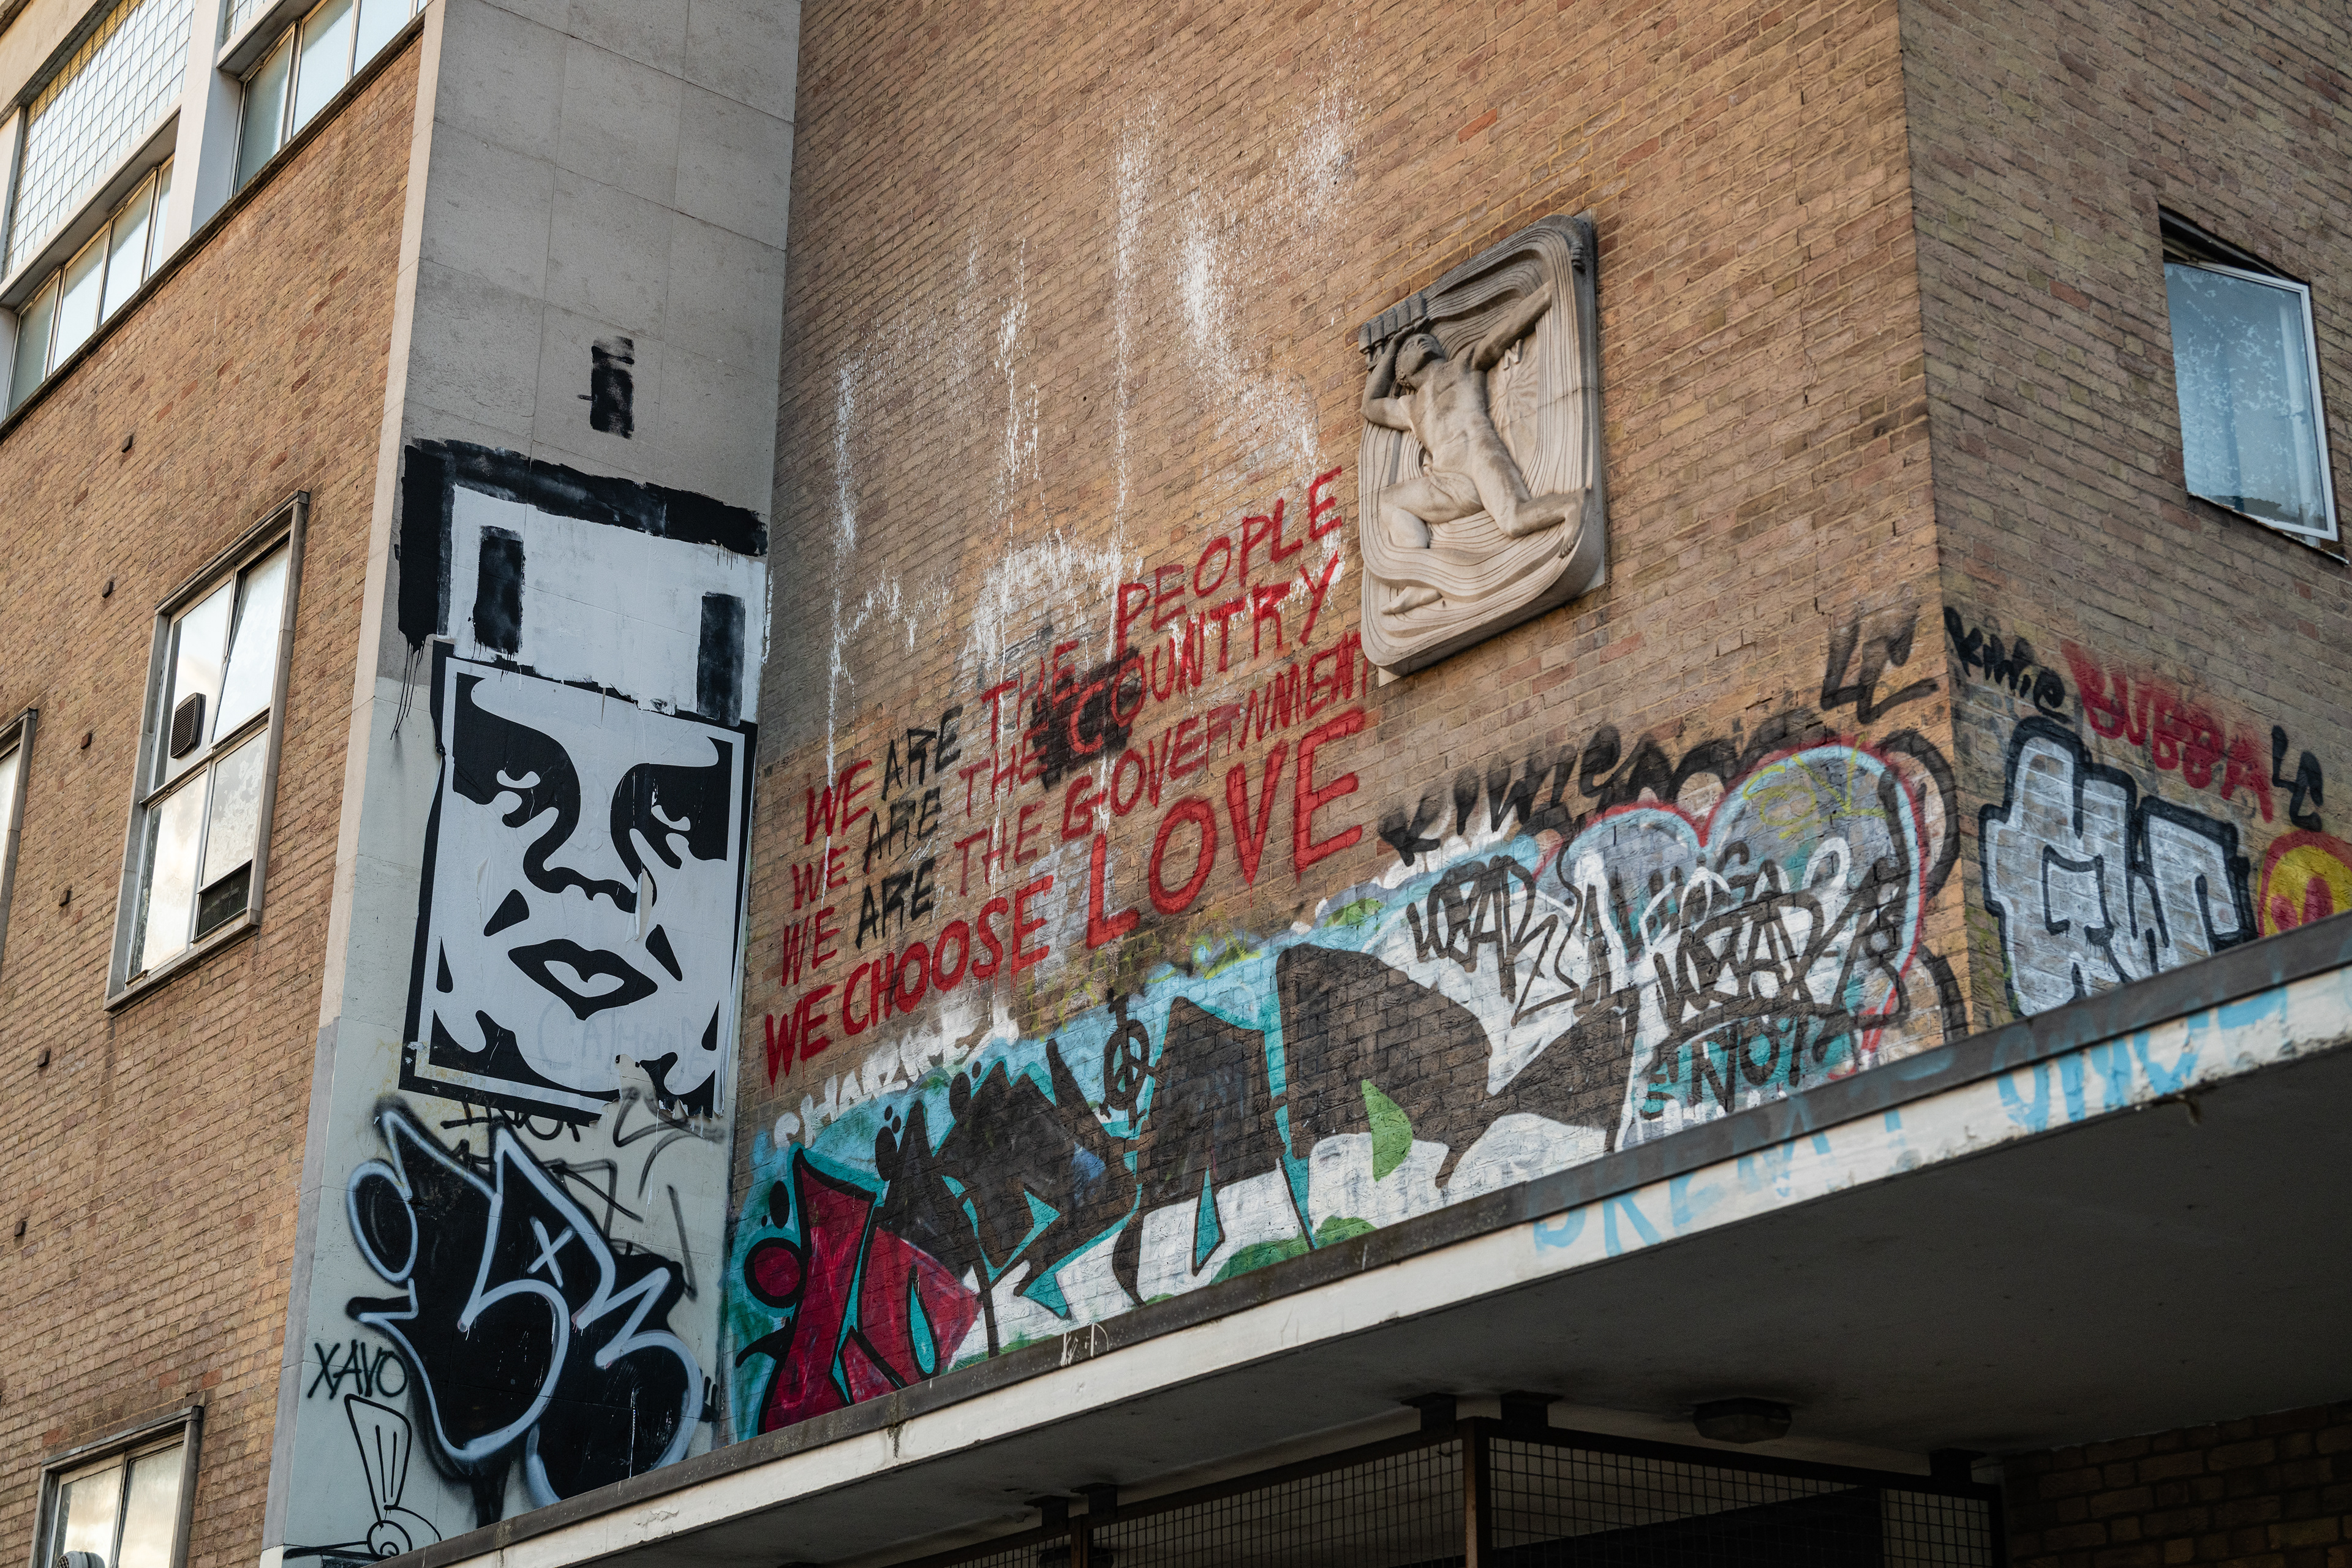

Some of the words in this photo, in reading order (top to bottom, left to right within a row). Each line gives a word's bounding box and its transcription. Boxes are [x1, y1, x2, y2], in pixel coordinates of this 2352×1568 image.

[793, 844, 849, 910] WE
[862, 786, 942, 872] ARE
[959, 718, 1051, 818] THE
[1069, 551, 1340, 755] COUNTRY
[805, 760, 873, 845] WE
[880, 706, 963, 802] ARE
[981, 641, 1080, 748] THE
[1116, 464, 1344, 654] PEOPLE
[764, 982, 835, 1099] WE
[842, 873, 1054, 1038] CHOOSE
[1085, 704, 1367, 952] LOVE
[781, 905, 842, 987] WE
[855, 859, 937, 949] ARE
[954, 799, 1046, 897] THE
[307, 1338, 409, 1400] XAVO
